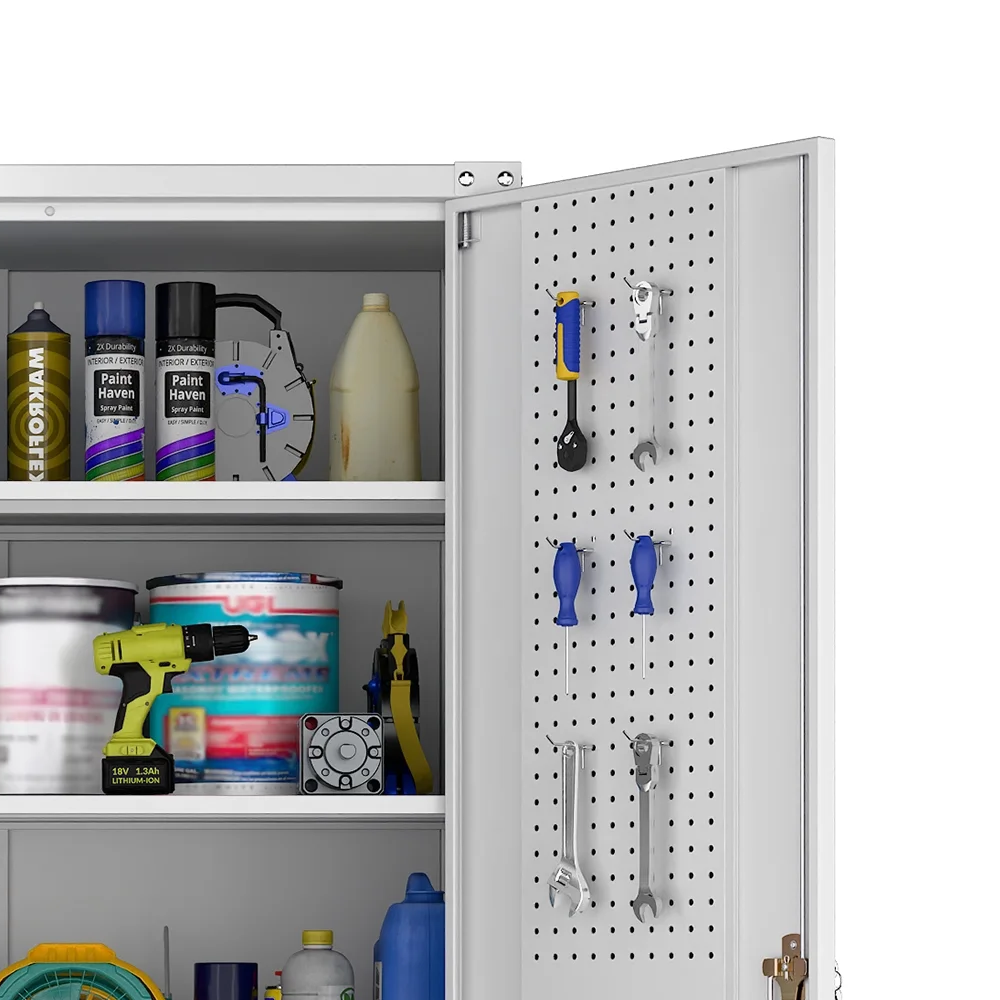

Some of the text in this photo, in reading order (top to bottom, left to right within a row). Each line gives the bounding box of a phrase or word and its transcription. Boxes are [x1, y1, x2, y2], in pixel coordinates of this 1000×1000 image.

[105, 342, 137, 353] Durability
[176, 344, 208, 355] Durability
[101, 372, 132, 385] Paint
[172, 374, 203, 387] Paint
[98, 387, 135, 399] Haven
[169, 388, 206, 401] Haven
[100, 404, 117, 413] Spray
[171, 406, 188, 414] Spray
[112, 767, 159, 775] 18V 1.3Ah
